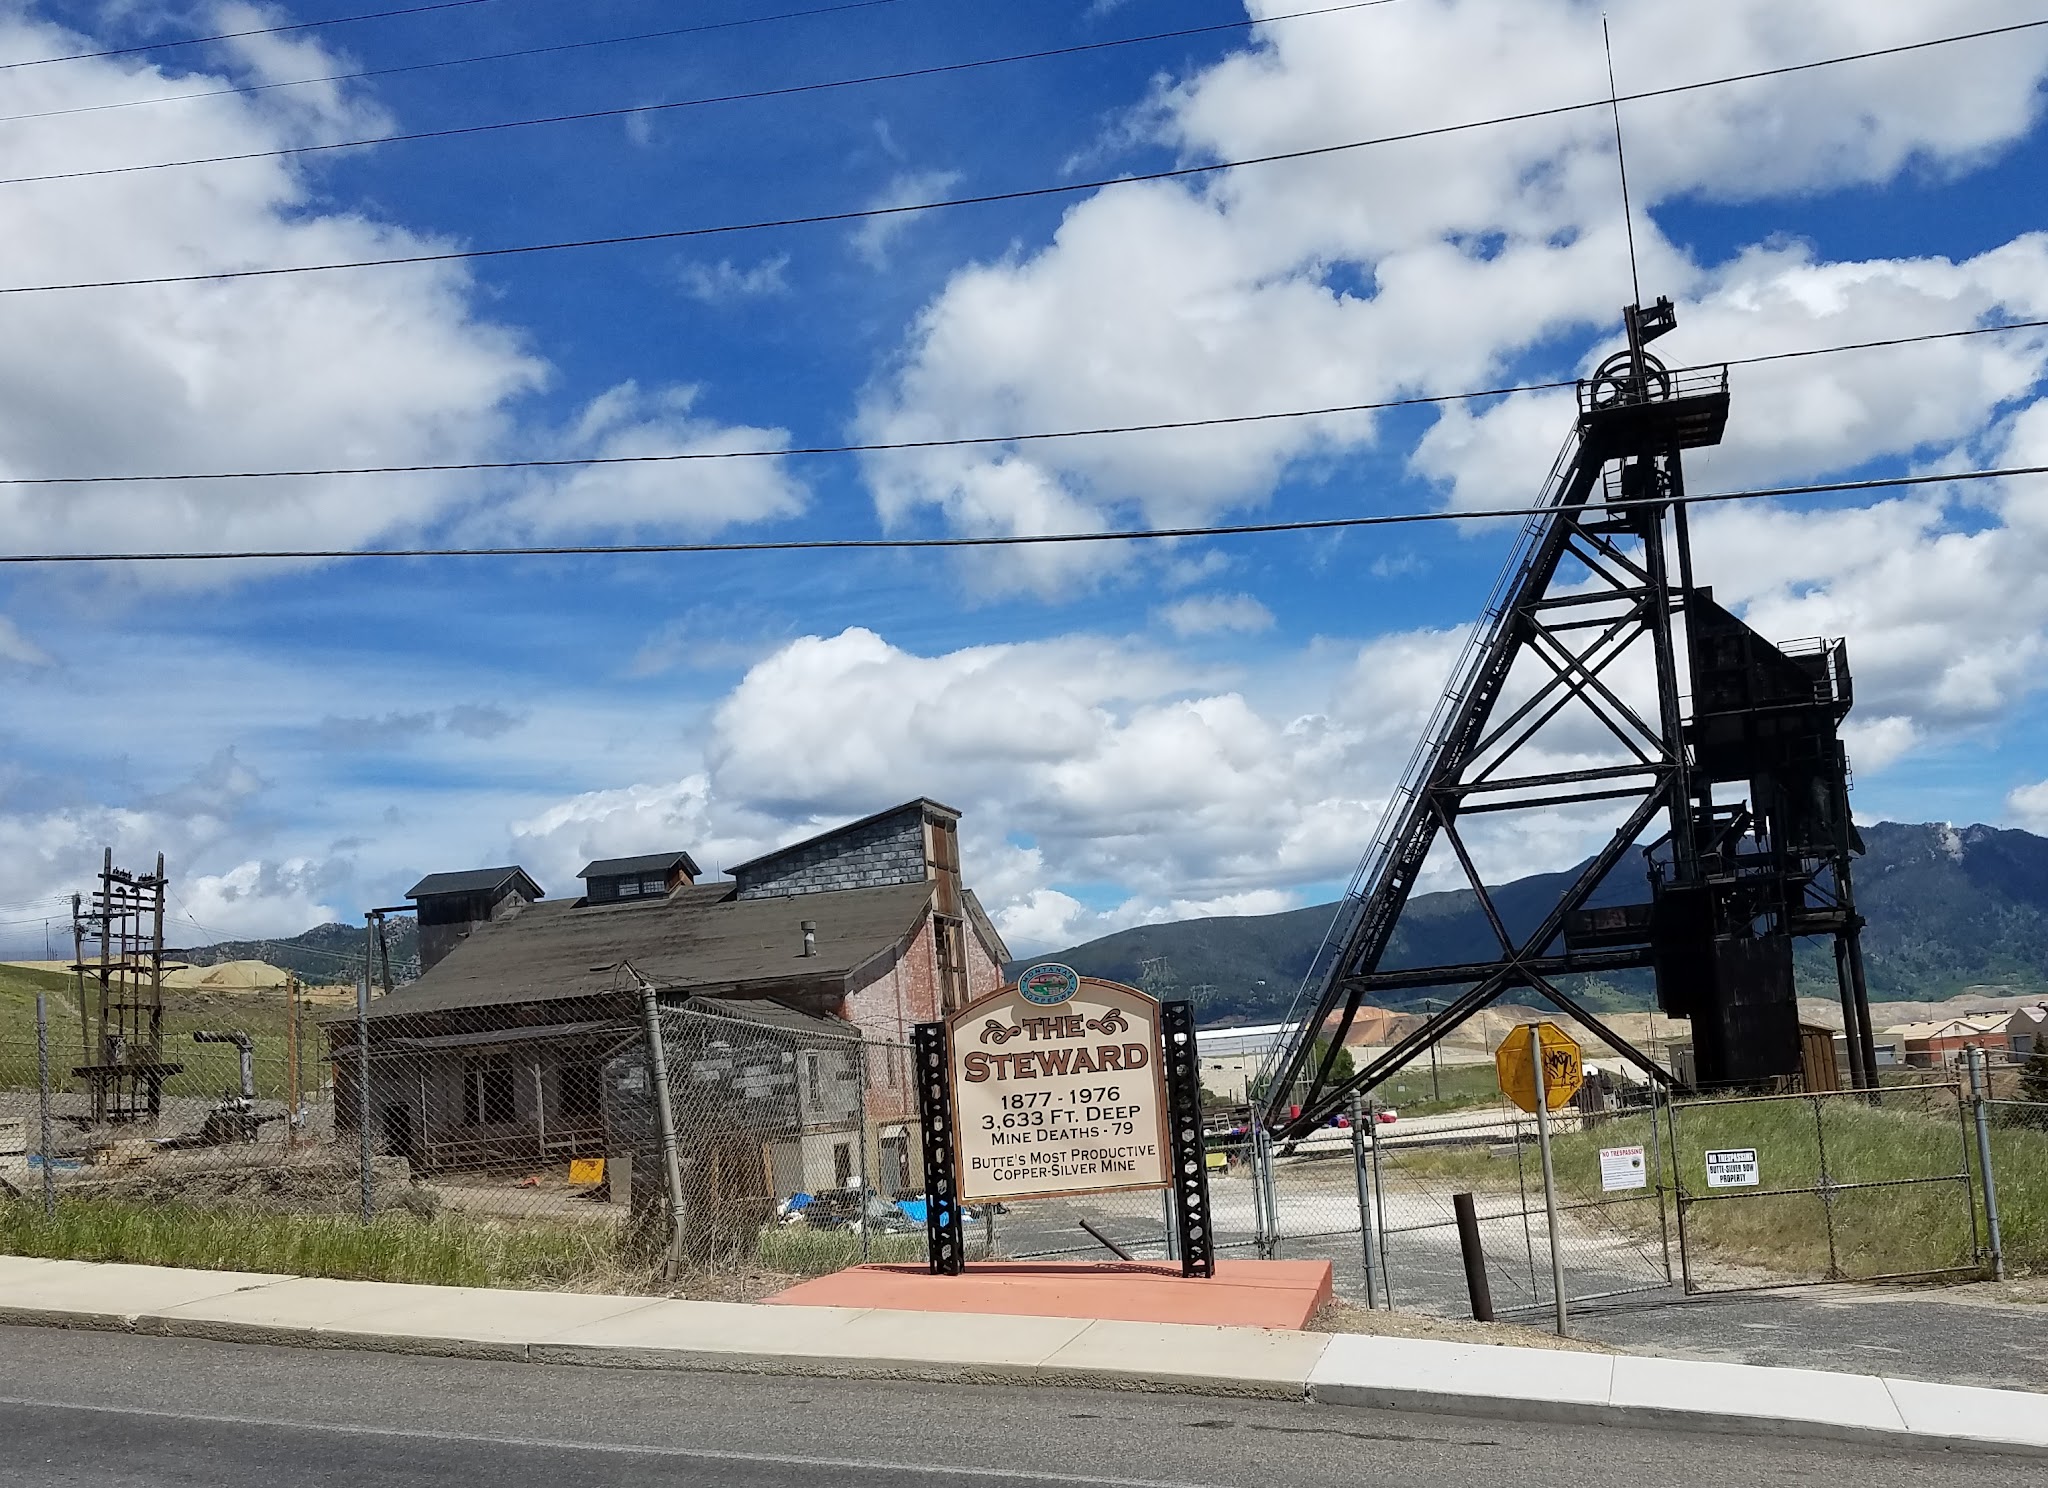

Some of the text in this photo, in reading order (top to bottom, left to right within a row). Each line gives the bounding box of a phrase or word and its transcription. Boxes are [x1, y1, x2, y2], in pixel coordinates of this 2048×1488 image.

[1023, 967, 1074, 982] MONTANA'S
[1023, 986, 1074, 1003] COPPERWAY
[1022, 1014, 1086, 1041] THE
[964, 1043, 1149, 1083] STEWARD
[1001, 1091, 1052, 1110] 1877
[1069, 1086, 1121, 1105] 1976
[981, 1105, 1141, 1132] 3,633 FT. DEEP
[991, 1131, 1032, 1146] MINE
[1036, 1127, 1100, 1142] DEATHS
[1111, 1121, 1134, 1136] 79
[972, 1144, 1156, 1170] BUTTE'S MOST PRODUCTIVE
[1610, 1148, 1643, 1157] TRESPASSING
[993, 1160, 1136, 1181] COPPER-SILVER MINE
